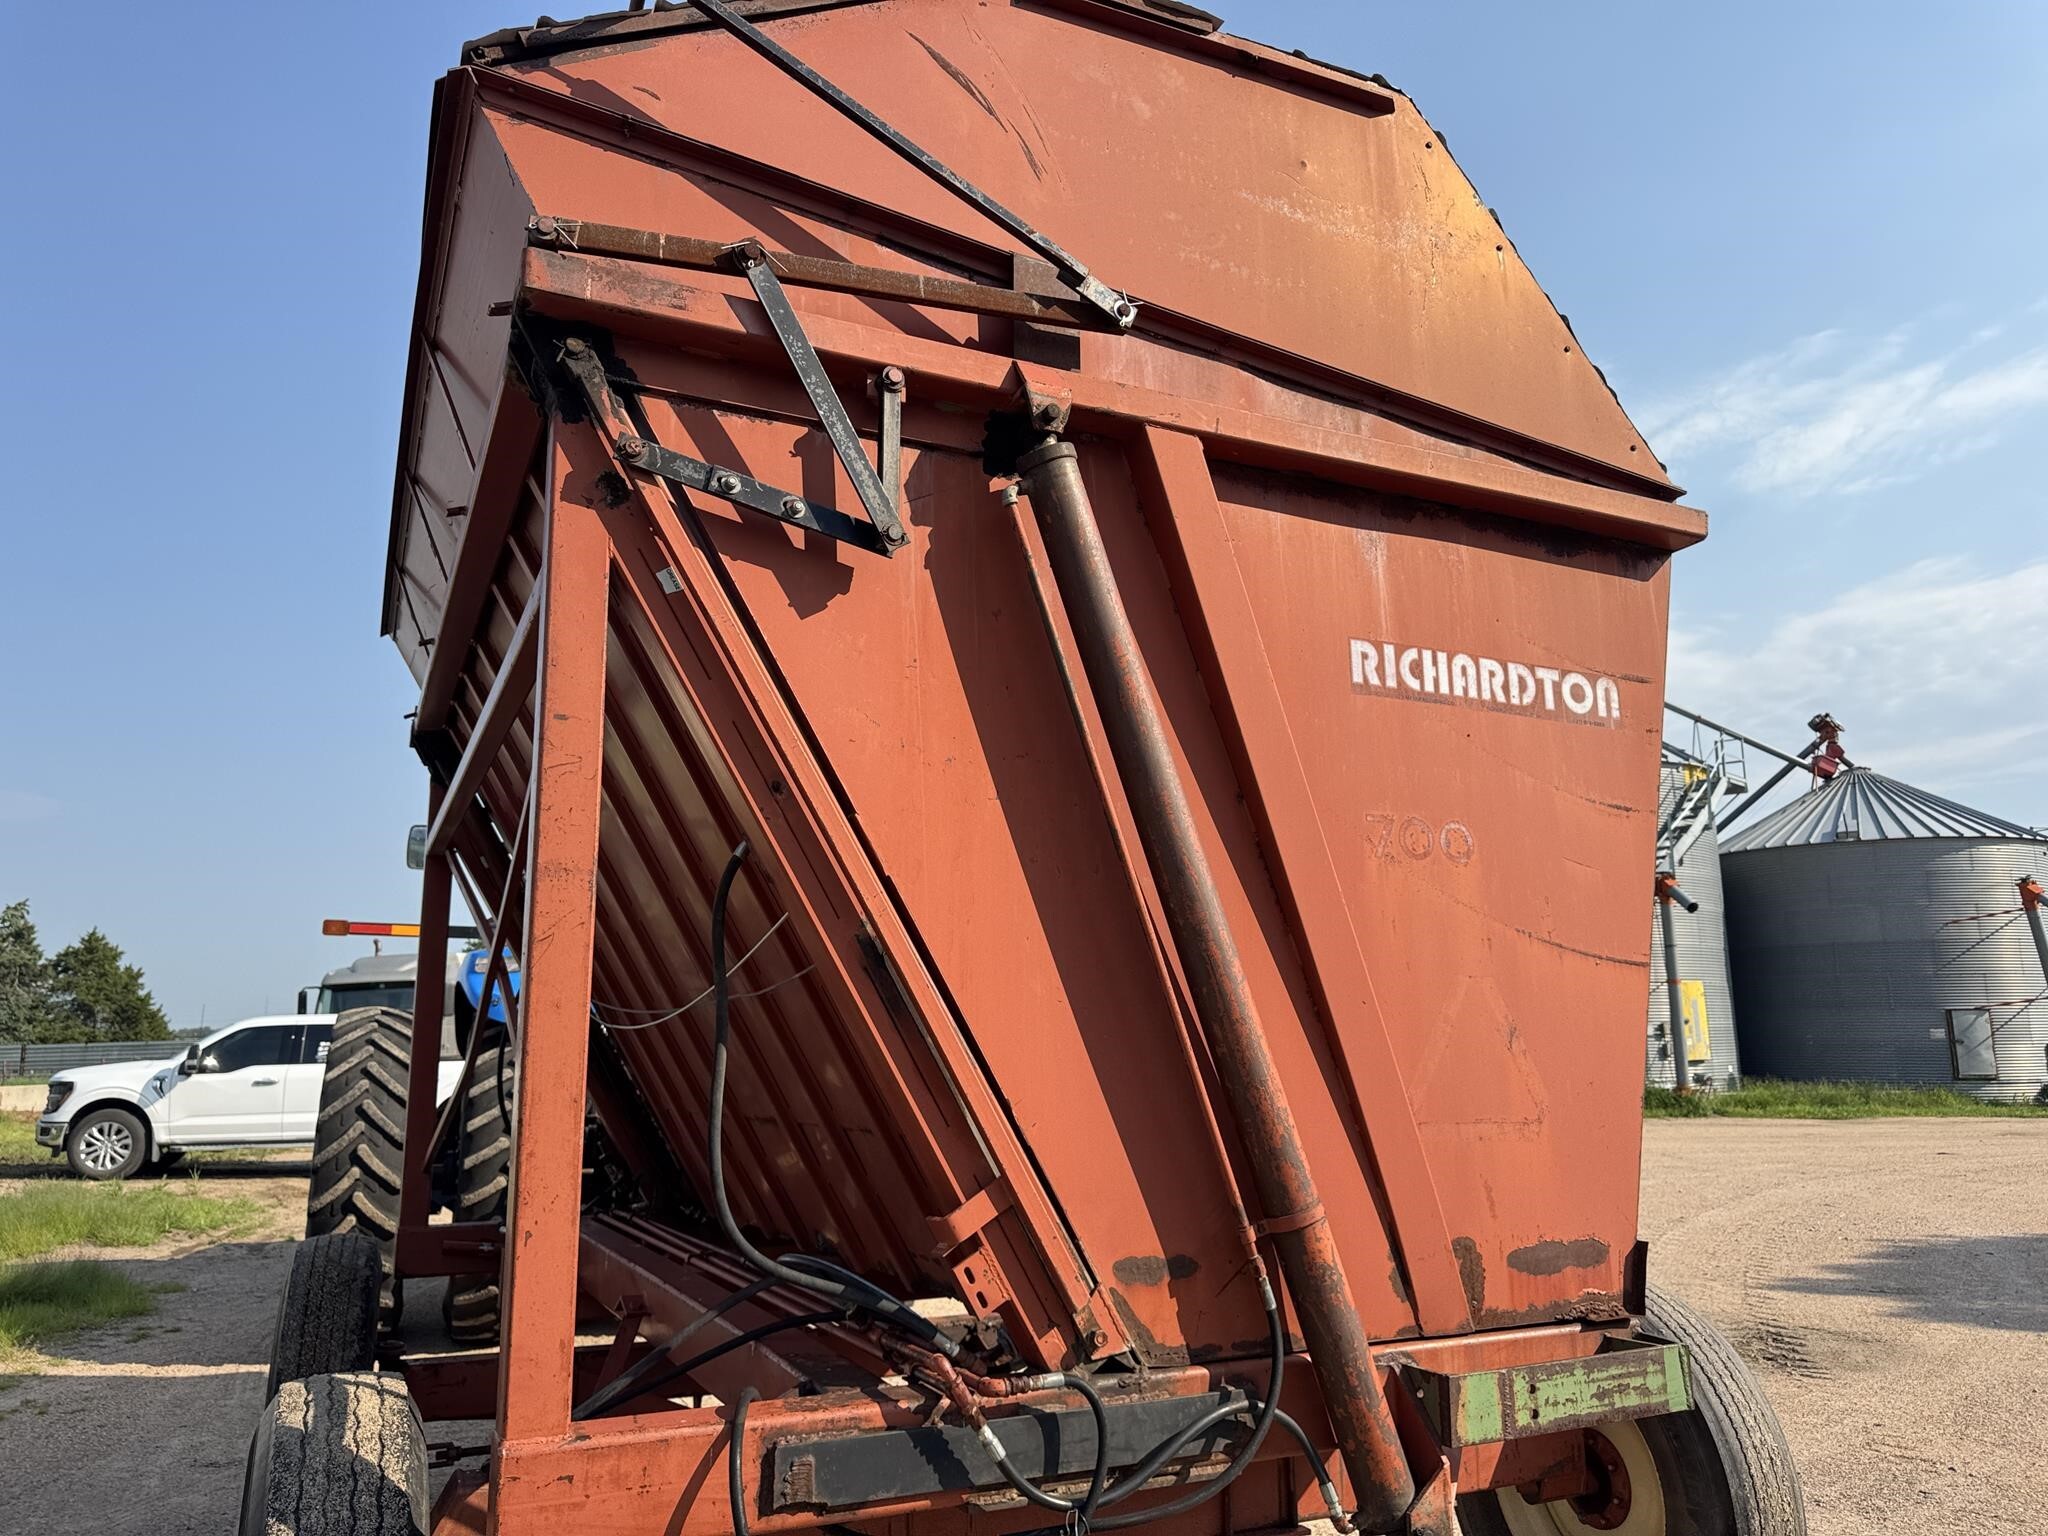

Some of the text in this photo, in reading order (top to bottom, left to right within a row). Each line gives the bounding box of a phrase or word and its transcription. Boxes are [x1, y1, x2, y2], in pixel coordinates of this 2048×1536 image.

[666, 568, 680, 590] GREASE
[1350, 638, 1620, 719] RICHARDTON
[1365, 814, 1474, 864] 700
